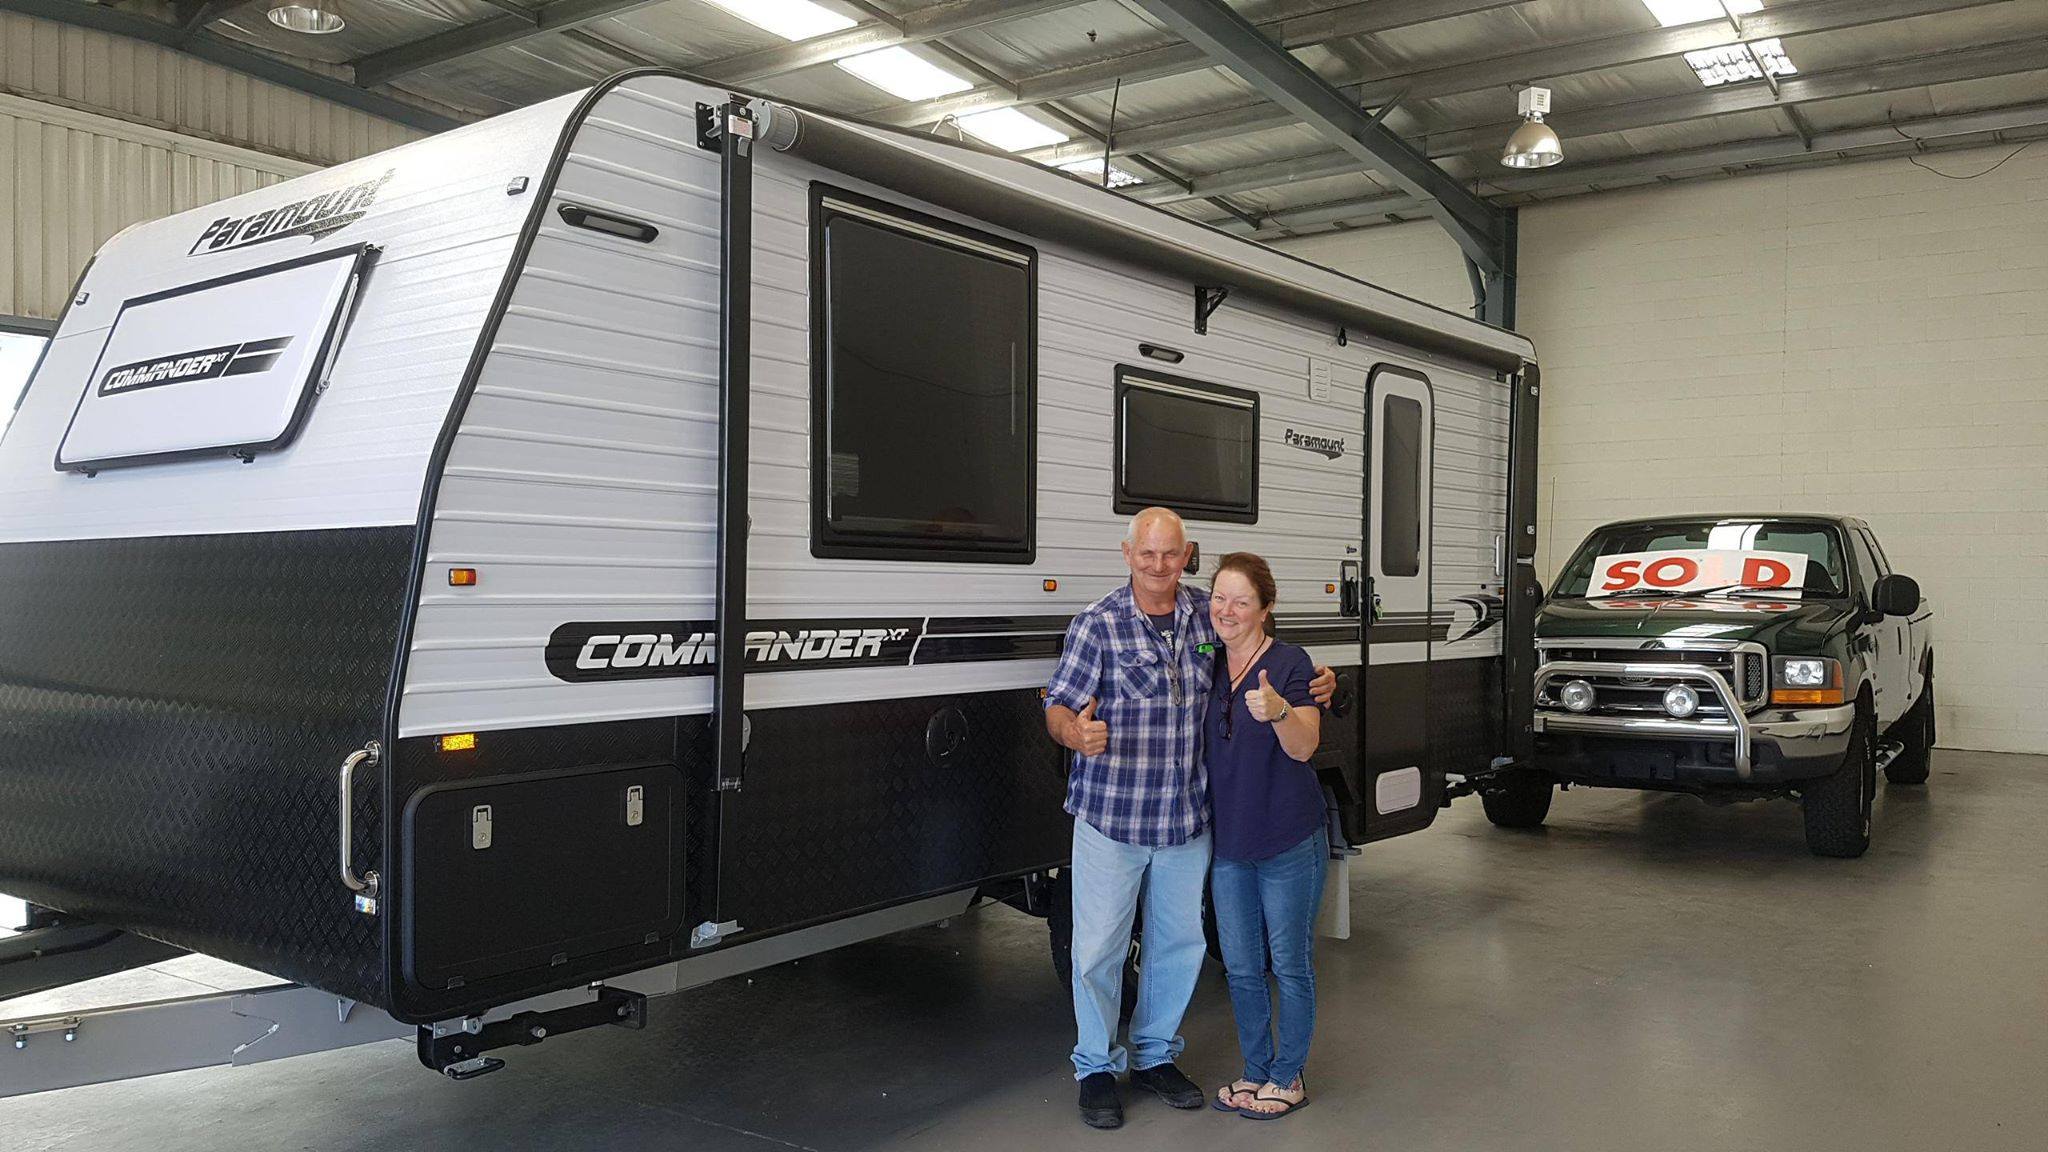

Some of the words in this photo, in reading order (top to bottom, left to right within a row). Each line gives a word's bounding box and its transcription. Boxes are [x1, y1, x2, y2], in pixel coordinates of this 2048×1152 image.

[188, 168, 396, 255] Paramount
[103, 353, 215, 391] COMMANDER
[1285, 428, 1344, 453] Paramount
[1601, 557, 1791, 590] SOD
